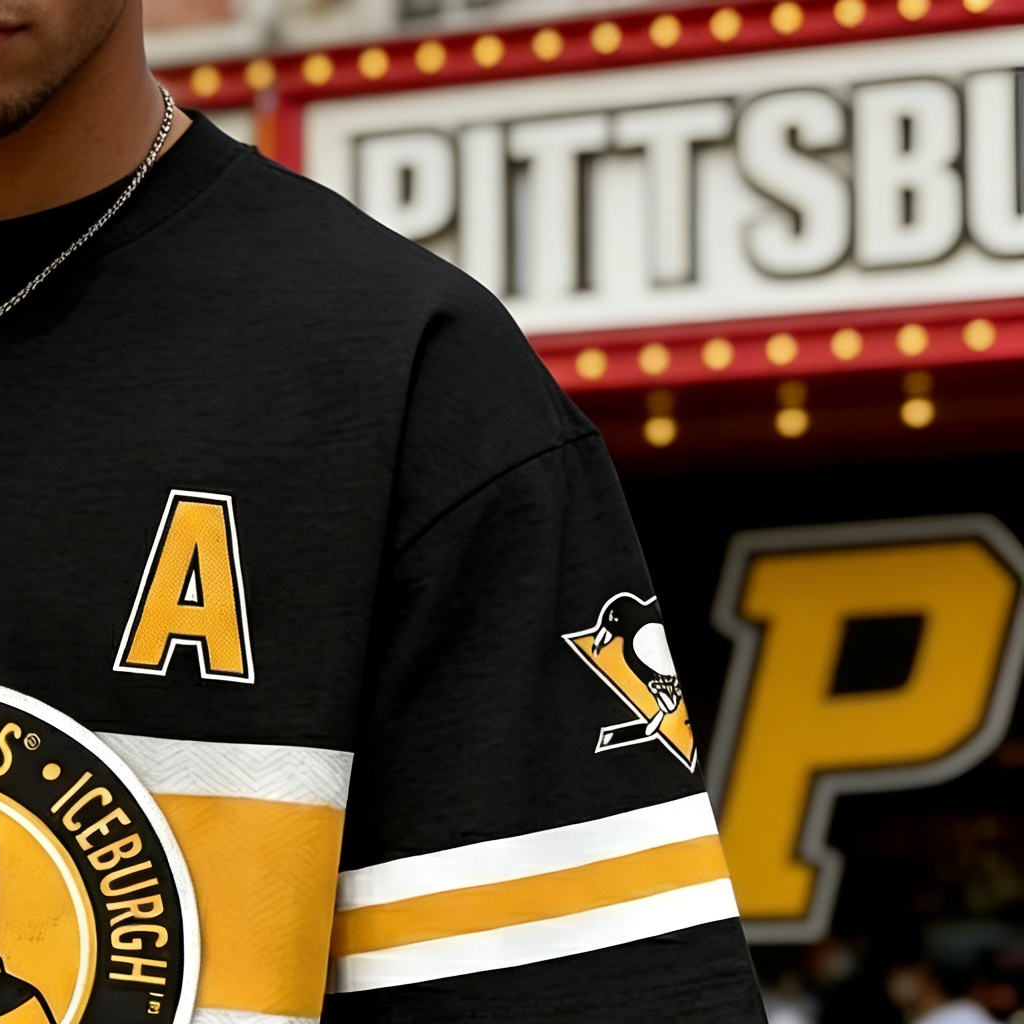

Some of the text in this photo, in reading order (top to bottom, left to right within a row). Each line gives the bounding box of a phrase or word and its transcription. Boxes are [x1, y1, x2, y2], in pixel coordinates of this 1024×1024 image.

[113, 489, 255, 684] A
[706, 513, 1024, 945] P
[50, 771, 169, 986] ICEBURGH
